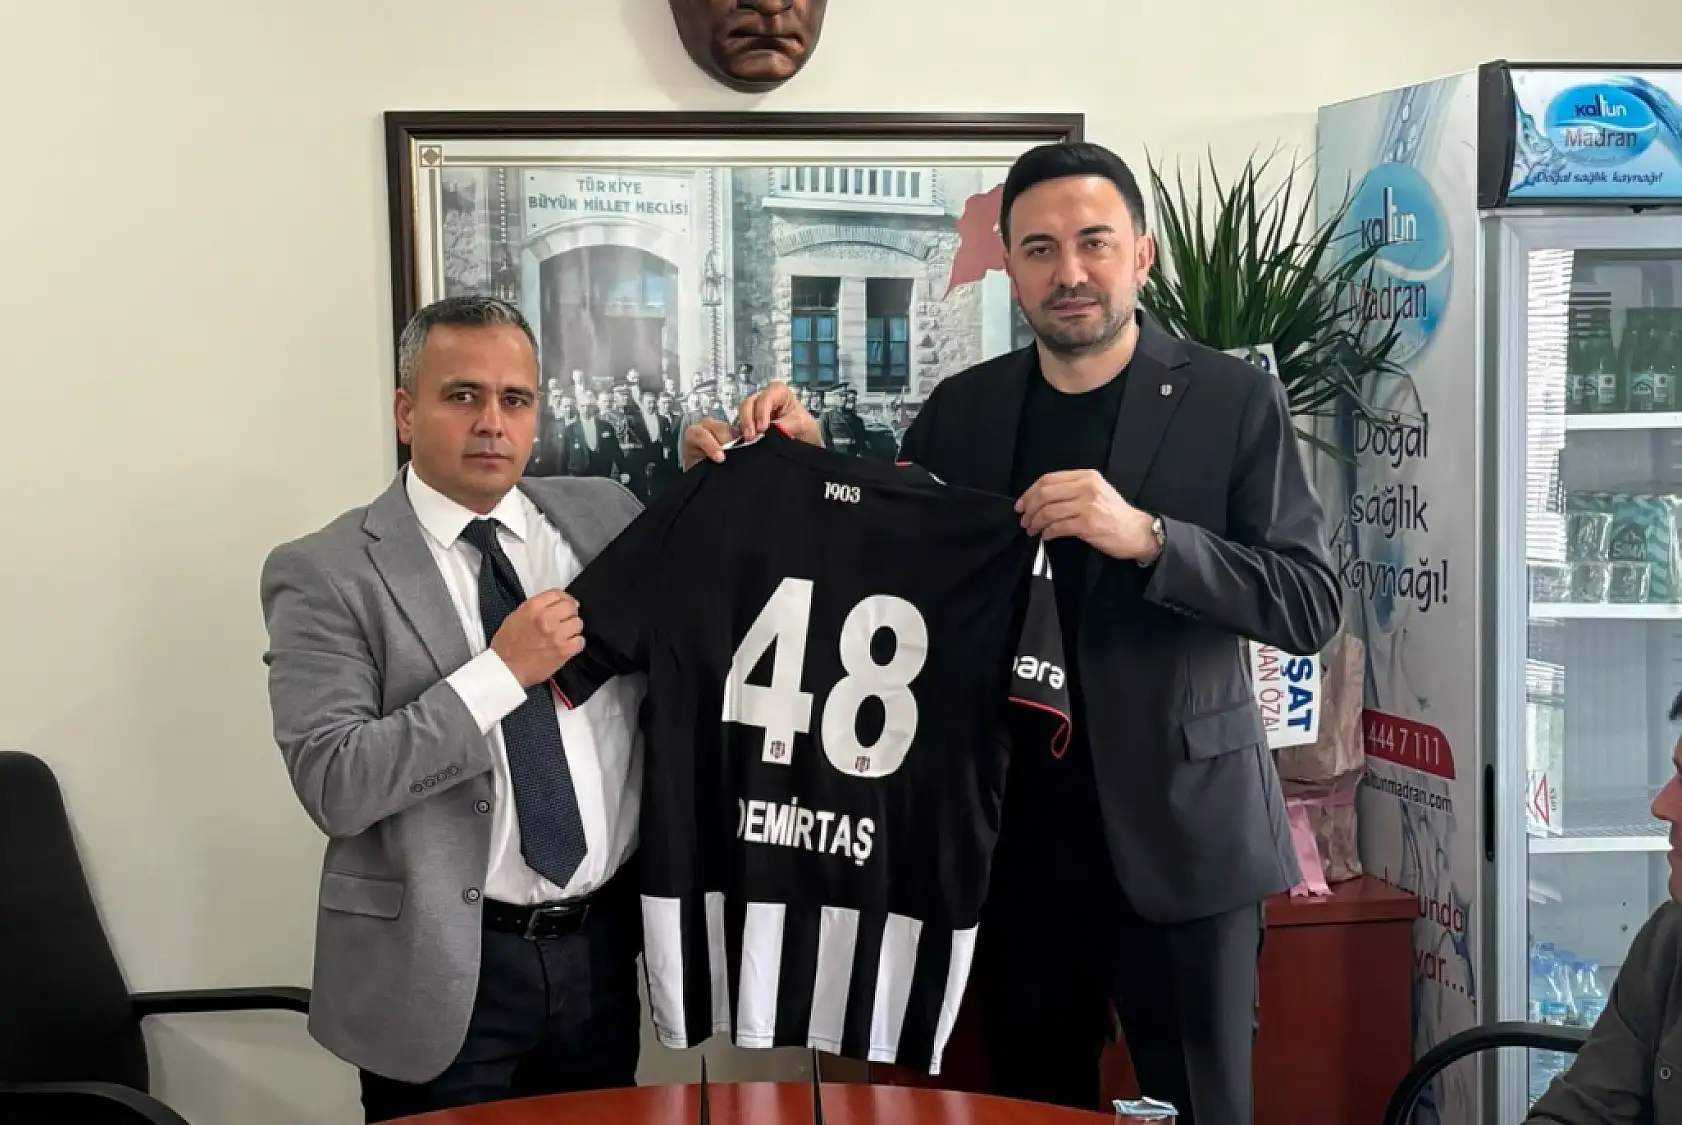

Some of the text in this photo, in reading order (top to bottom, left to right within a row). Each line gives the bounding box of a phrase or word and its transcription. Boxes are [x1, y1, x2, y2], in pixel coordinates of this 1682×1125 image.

[1565, 128, 1637, 148] Madran
[528, 193, 689, 216] BÜYÜK MİLLET MECLİSİ
[576, 176, 643, 195] TÜRKİYE
[1349, 277, 1428, 322] Madran
[1352, 412, 1429, 469] Doğal
[824, 481, 861, 503] 1903
[1351, 484, 1429, 539] sağlık
[1338, 543, 1448, 613] kaynağı!
[721, 576, 929, 779] 48
[1012, 655, 1066, 690] ara
[1368, 720, 1439, 766] 444 7 111
